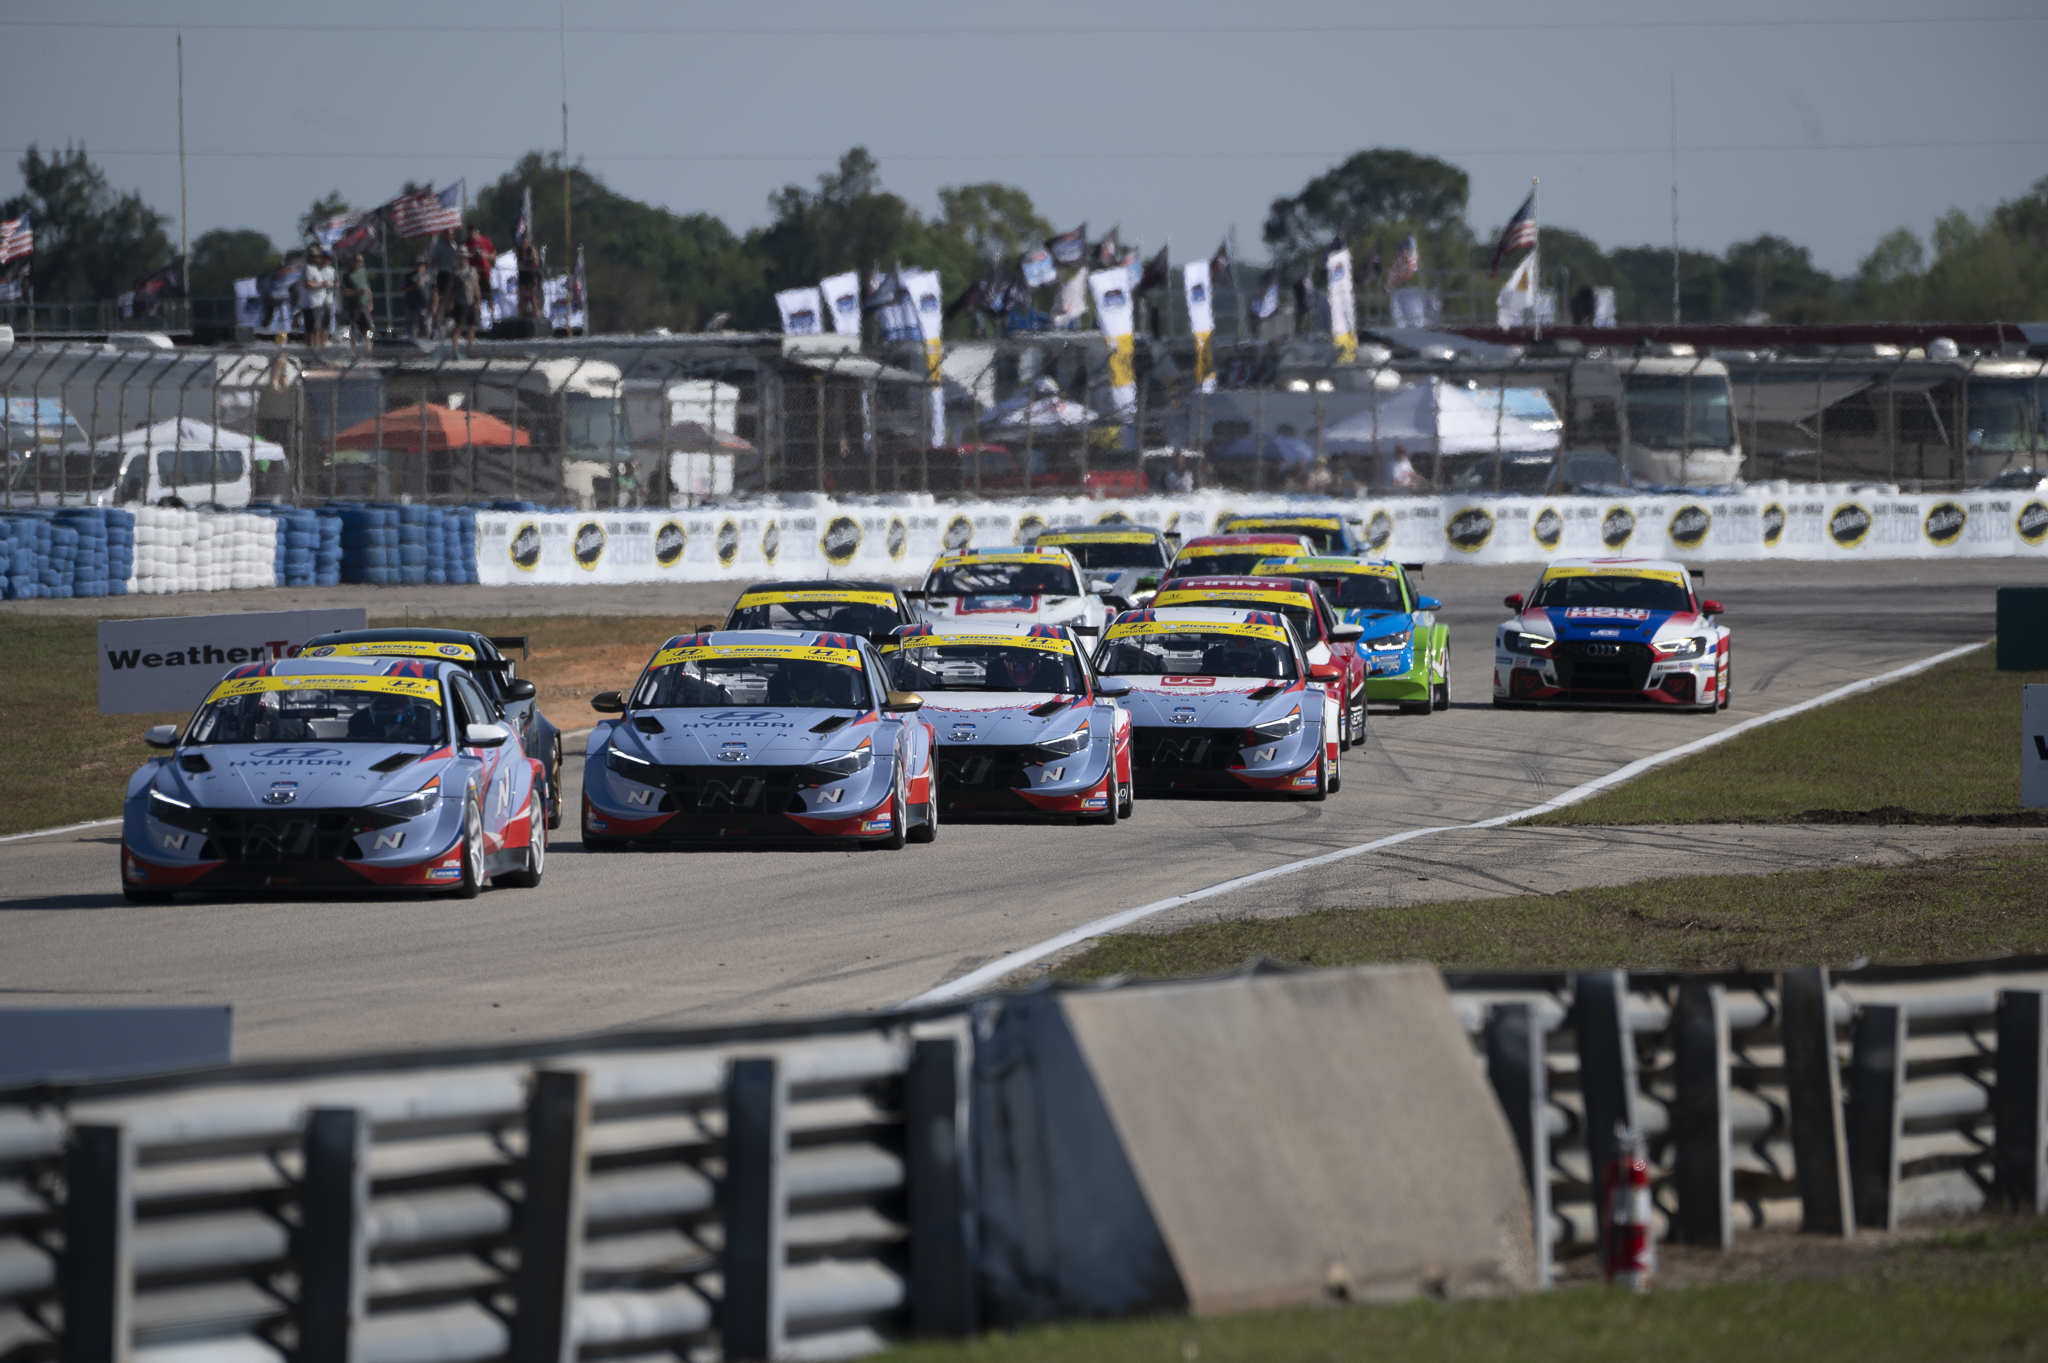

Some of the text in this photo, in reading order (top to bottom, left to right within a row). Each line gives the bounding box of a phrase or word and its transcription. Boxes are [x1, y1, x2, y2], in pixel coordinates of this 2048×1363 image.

[1109, 637, 1128, 647] 54
[223, 687, 266, 695] HYUNDAI
[381, 687, 426, 695] HYUNDAI
[216, 695, 242, 707] 33
[1253, 748, 1278, 762] N
[229, 759, 352, 767] HYUNDAI
[1040, 766, 1066, 783] N
[627, 790, 654, 805] N
[815, 788, 845, 804] N
[163, 833, 189, 850] N
[373, 831, 406, 850] N
